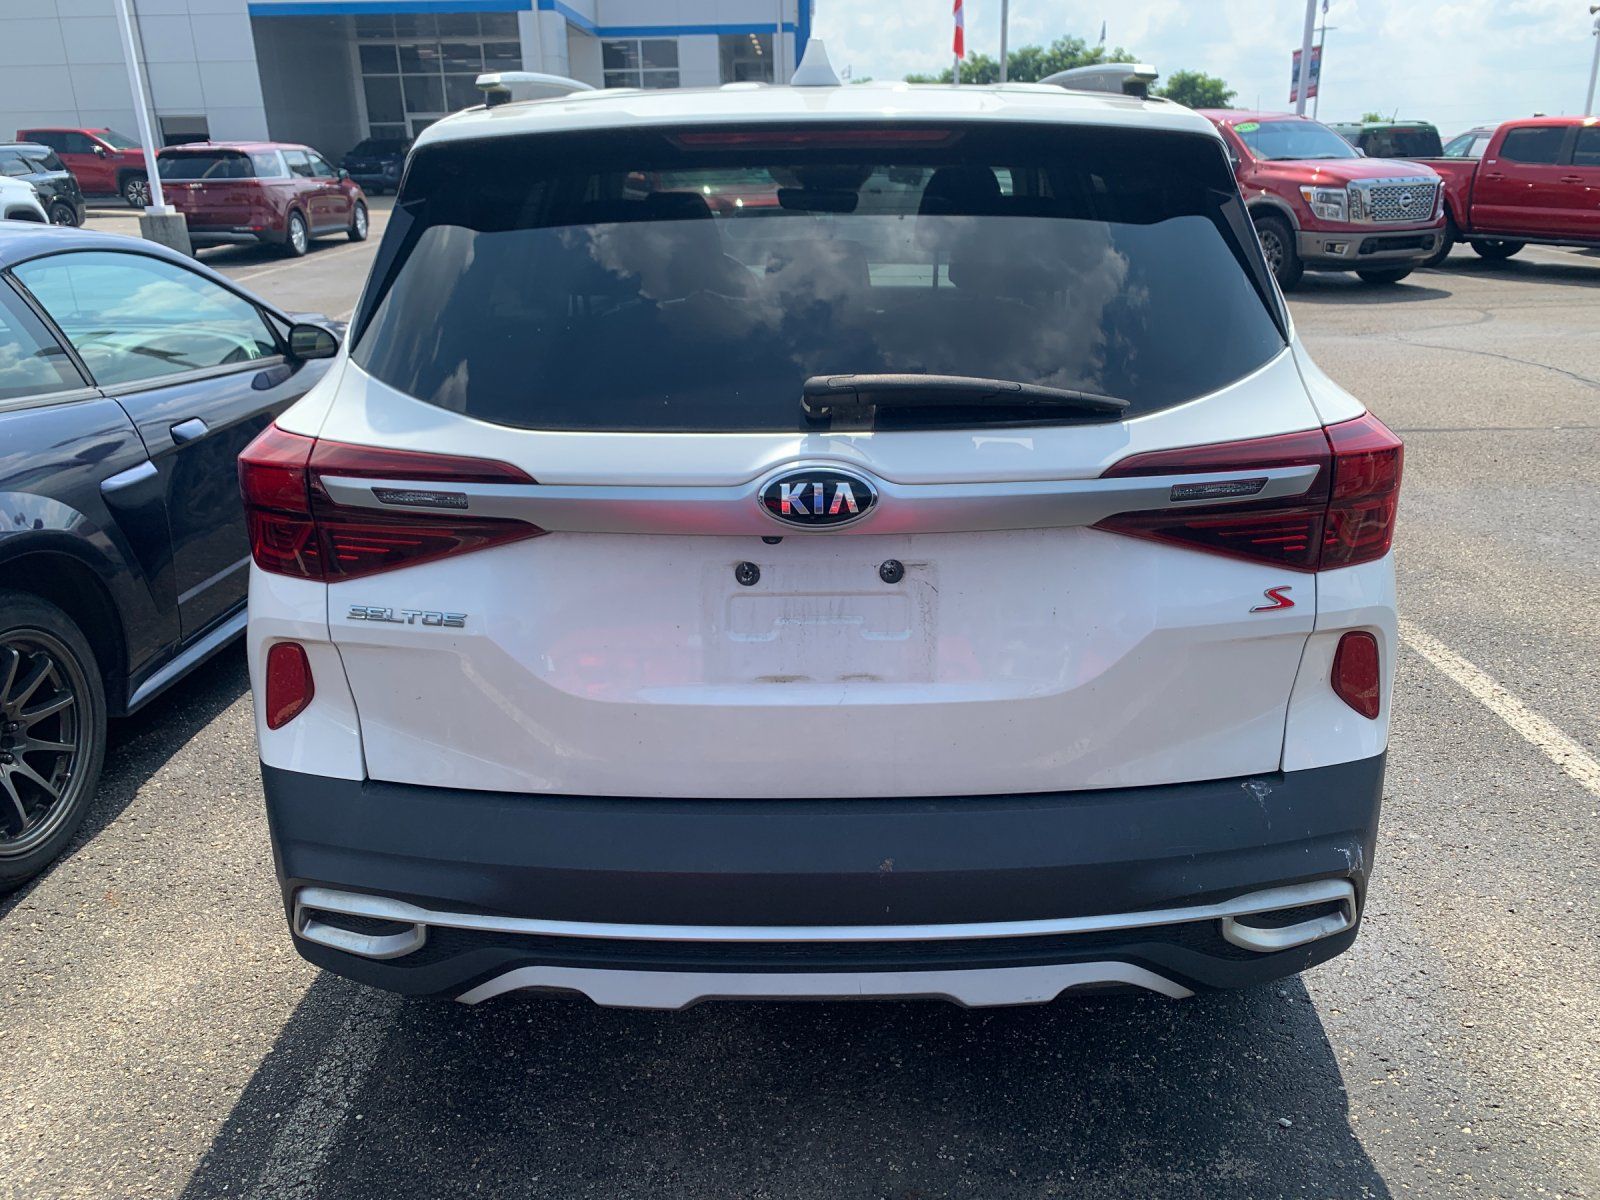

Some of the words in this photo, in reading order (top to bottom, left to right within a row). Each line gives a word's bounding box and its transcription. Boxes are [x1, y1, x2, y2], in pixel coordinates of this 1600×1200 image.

[780, 482, 859, 514] KIA
[1249, 585, 1295, 612] S
[346, 604, 468, 628] SELTOS
